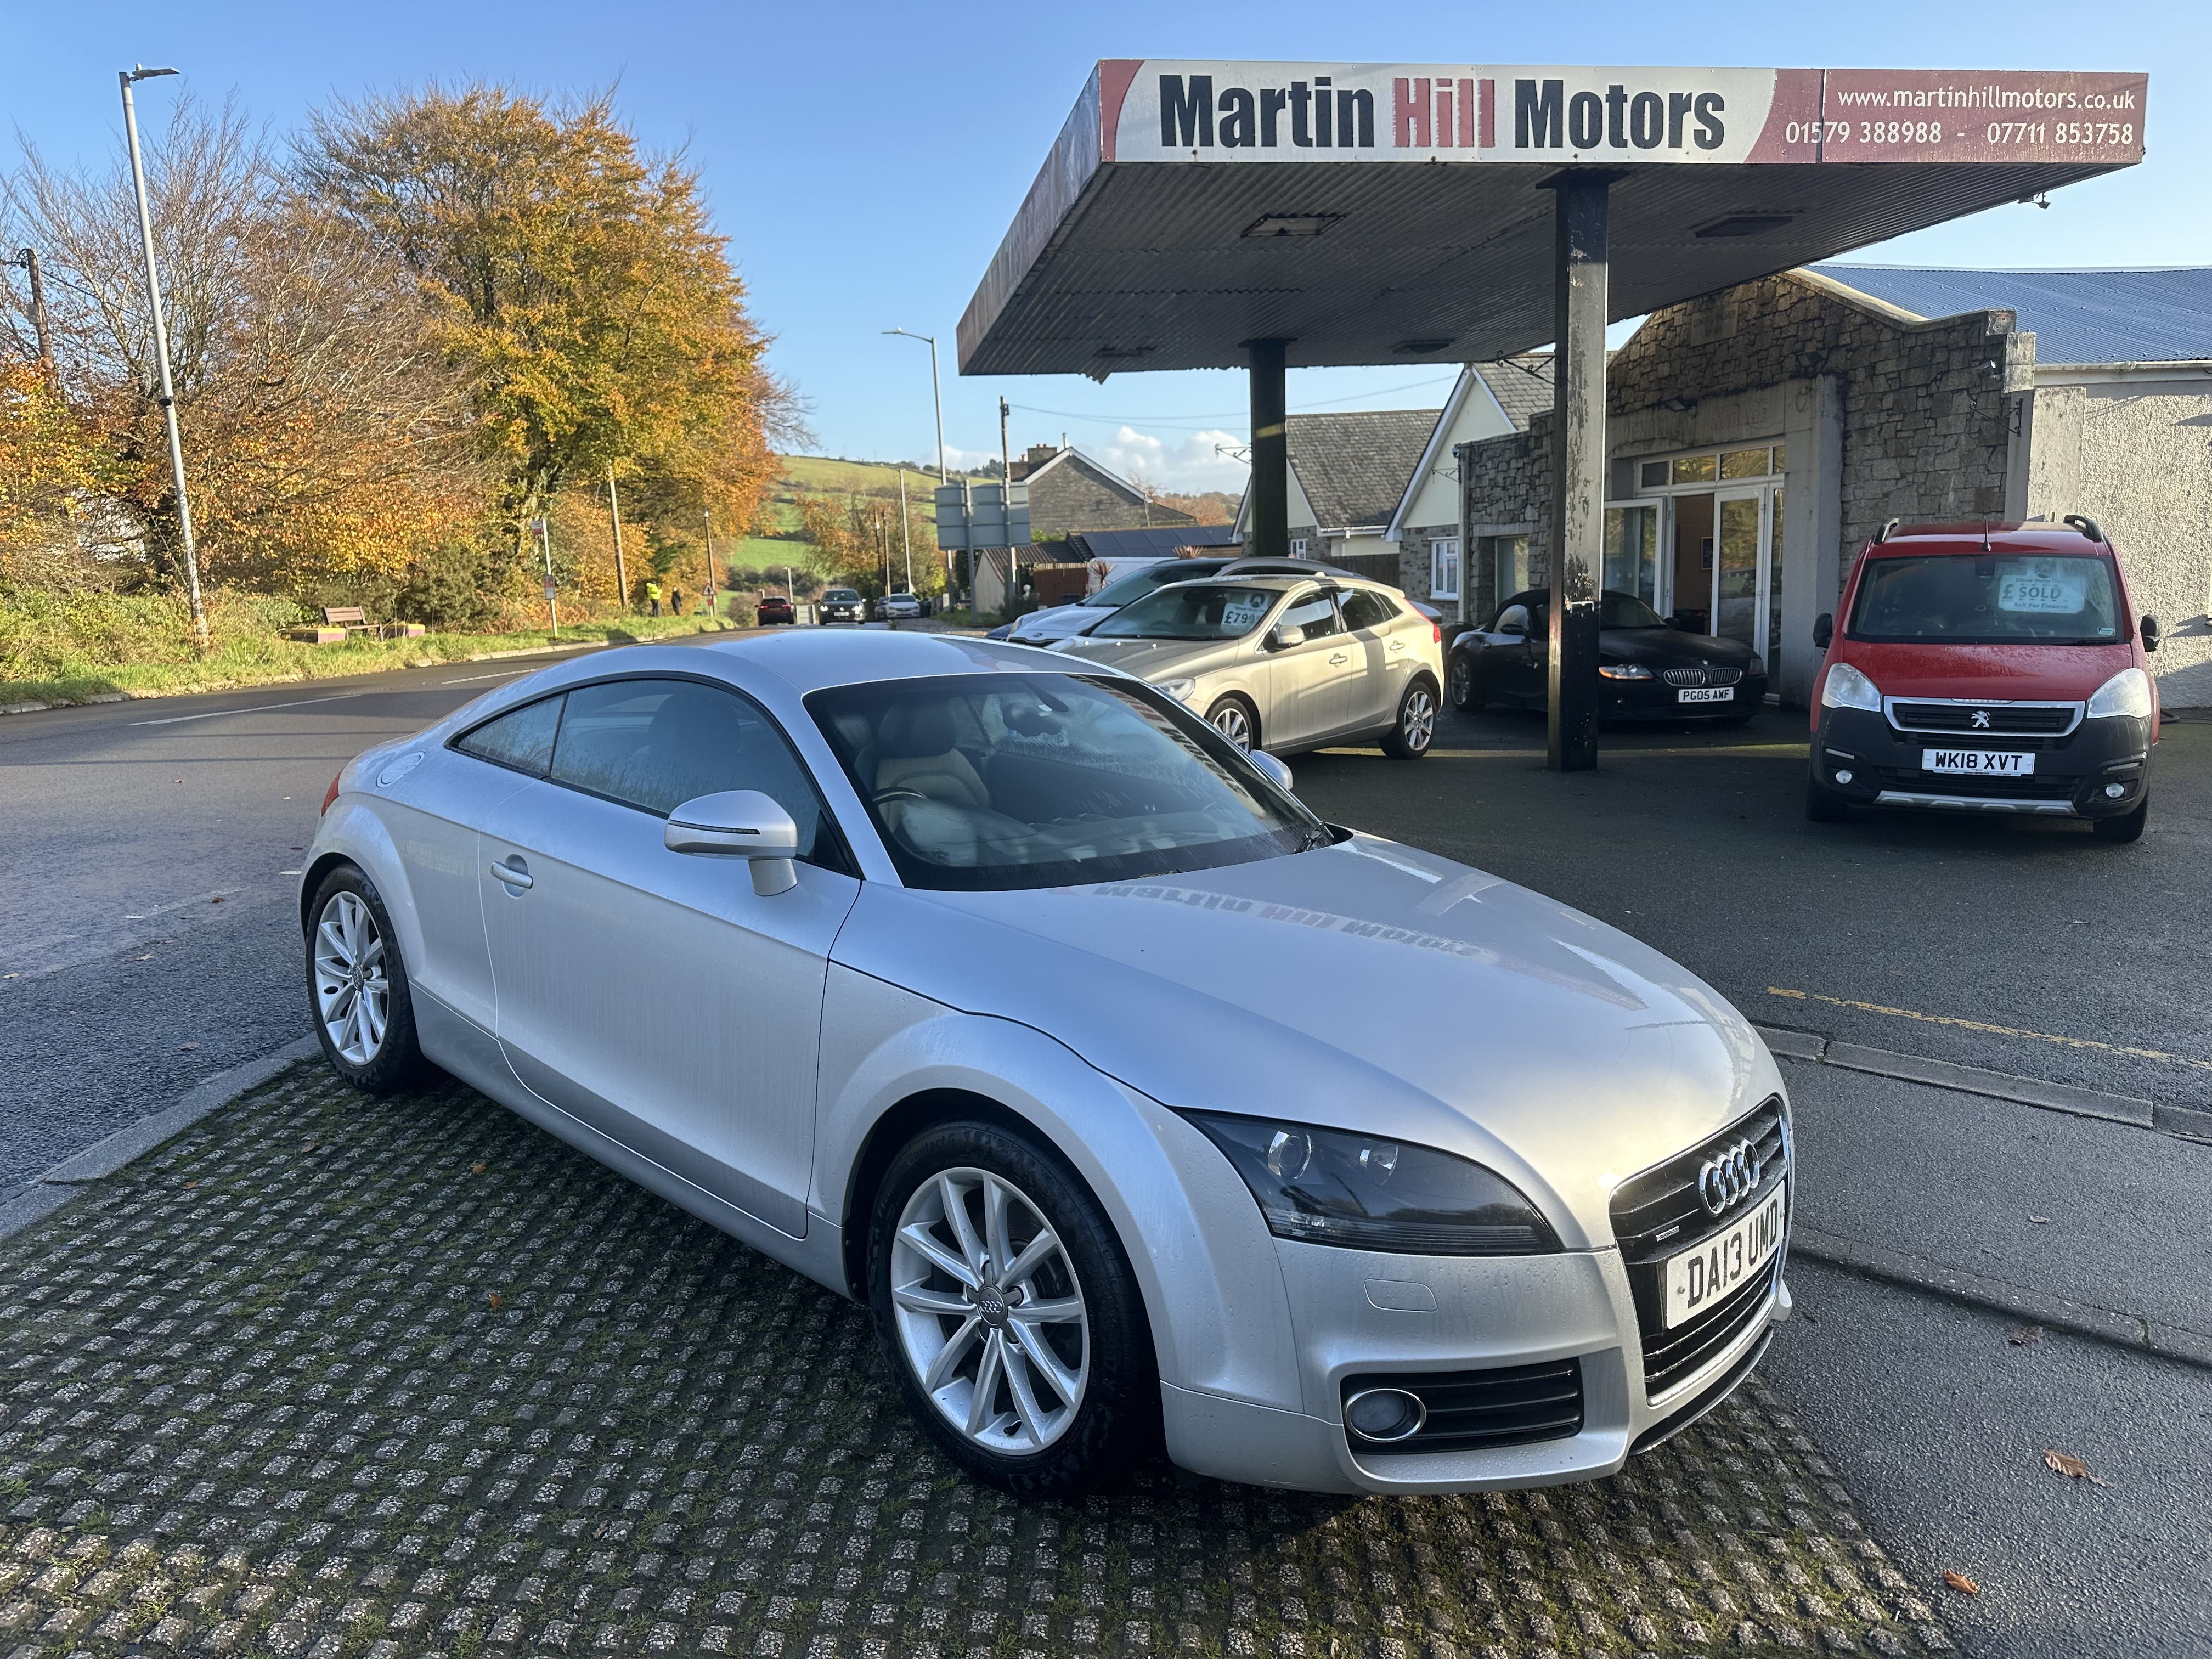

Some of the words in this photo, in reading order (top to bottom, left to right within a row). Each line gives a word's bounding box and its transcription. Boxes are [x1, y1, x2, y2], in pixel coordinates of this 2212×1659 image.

[1838, 86, 2135, 109] www.martinhillmotors.co.uk
[1159, 74, 1374, 148] Martin
[1392, 77, 1496, 148] Hill
[1514, 78, 1725, 150] Motors
[1785, 121, 1850, 144] 01579
[1859, 121, 1942, 143] 388988
[1987, 122, 2046, 144] 07711
[2055, 122, 2134, 144] 853758
[2018, 586, 2062, 599] SOLD
[1683, 690, 1709, 701] PG05
[1712, 689, 1730, 700] AWF
[1936, 752, 1978, 769] WK18
[1984, 754, 2023, 771] XVT
[1688, 1231, 1742, 1309] DA13
[1748, 1199, 1778, 1267] UMD
